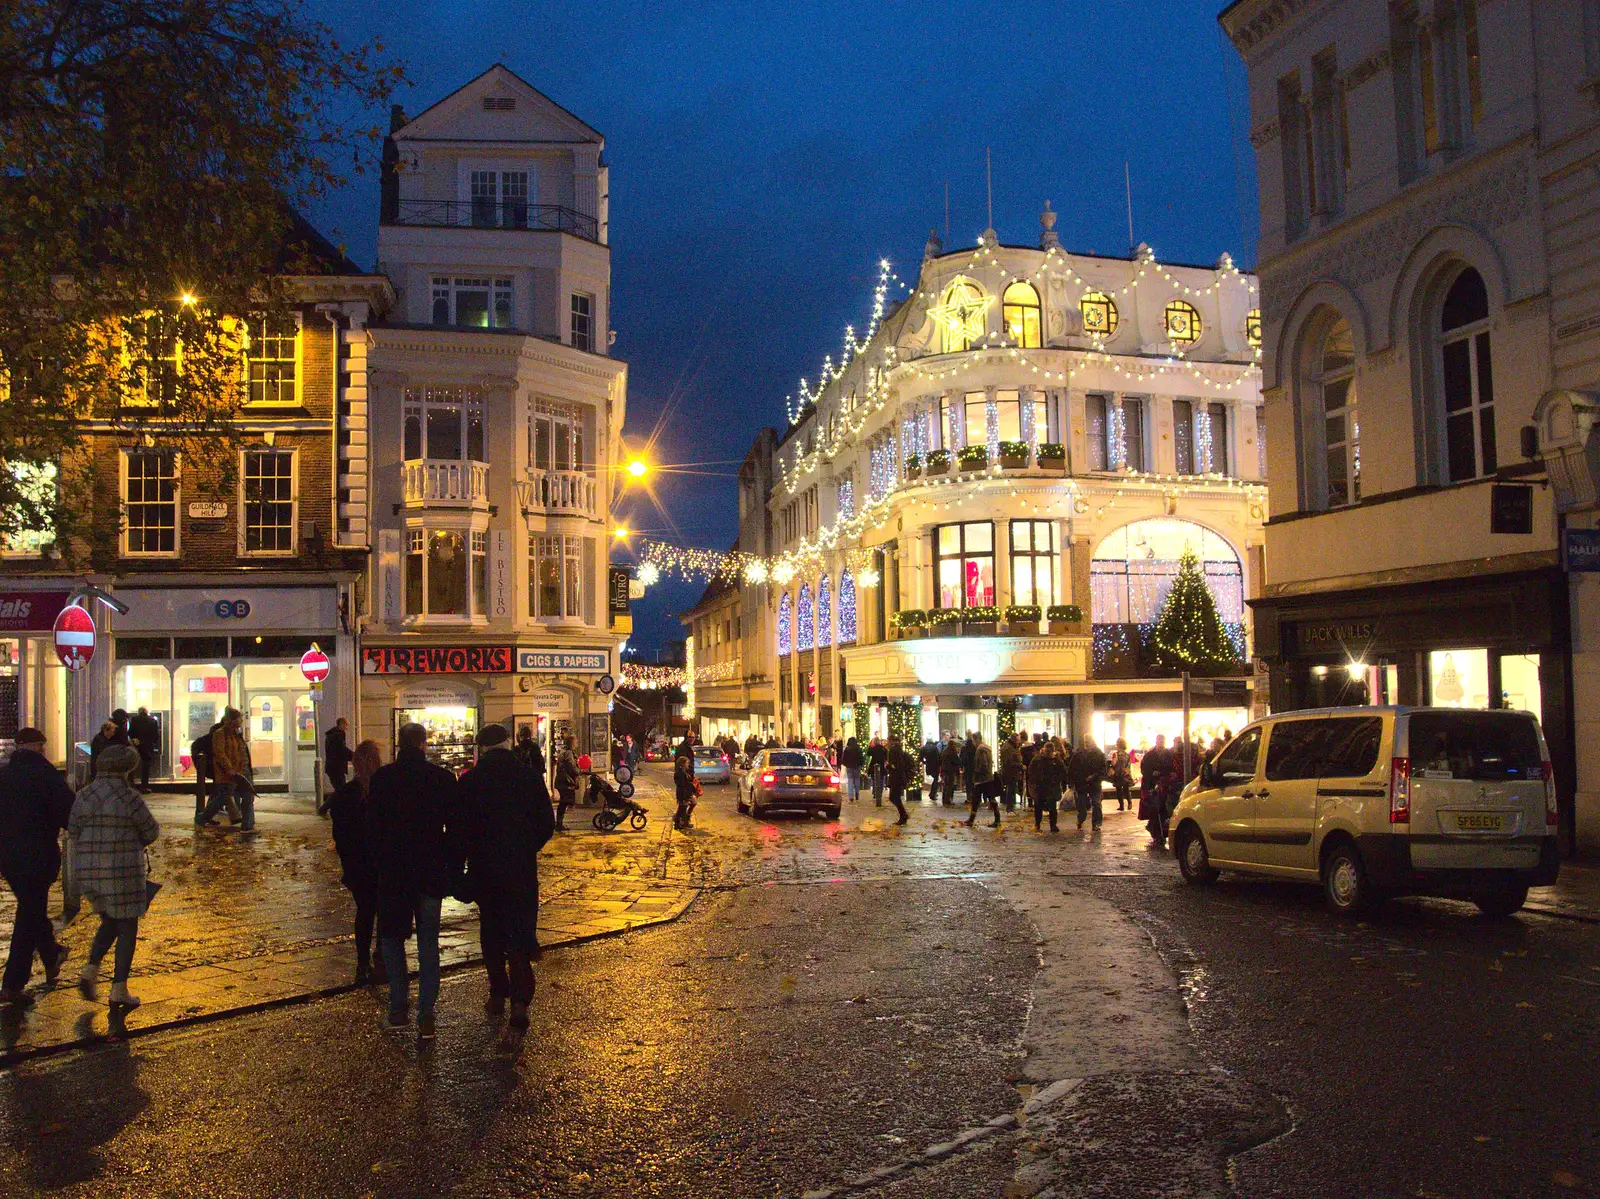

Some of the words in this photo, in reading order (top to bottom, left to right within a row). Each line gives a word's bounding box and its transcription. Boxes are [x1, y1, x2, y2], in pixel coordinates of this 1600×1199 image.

[498, 533, 504, 552] LE
[496, 559, 506, 615] BISTRO
[616, 574, 627, 608] BISTRO
[1305, 626, 1332, 642] JACK
[1336, 624, 1371, 639] WILLS
[368, 649, 506, 675] FIREWORKS
[526, 655, 551, 667] CIGS
[553, 655, 561, 667] &
[563, 656, 600, 667] PAPERS
